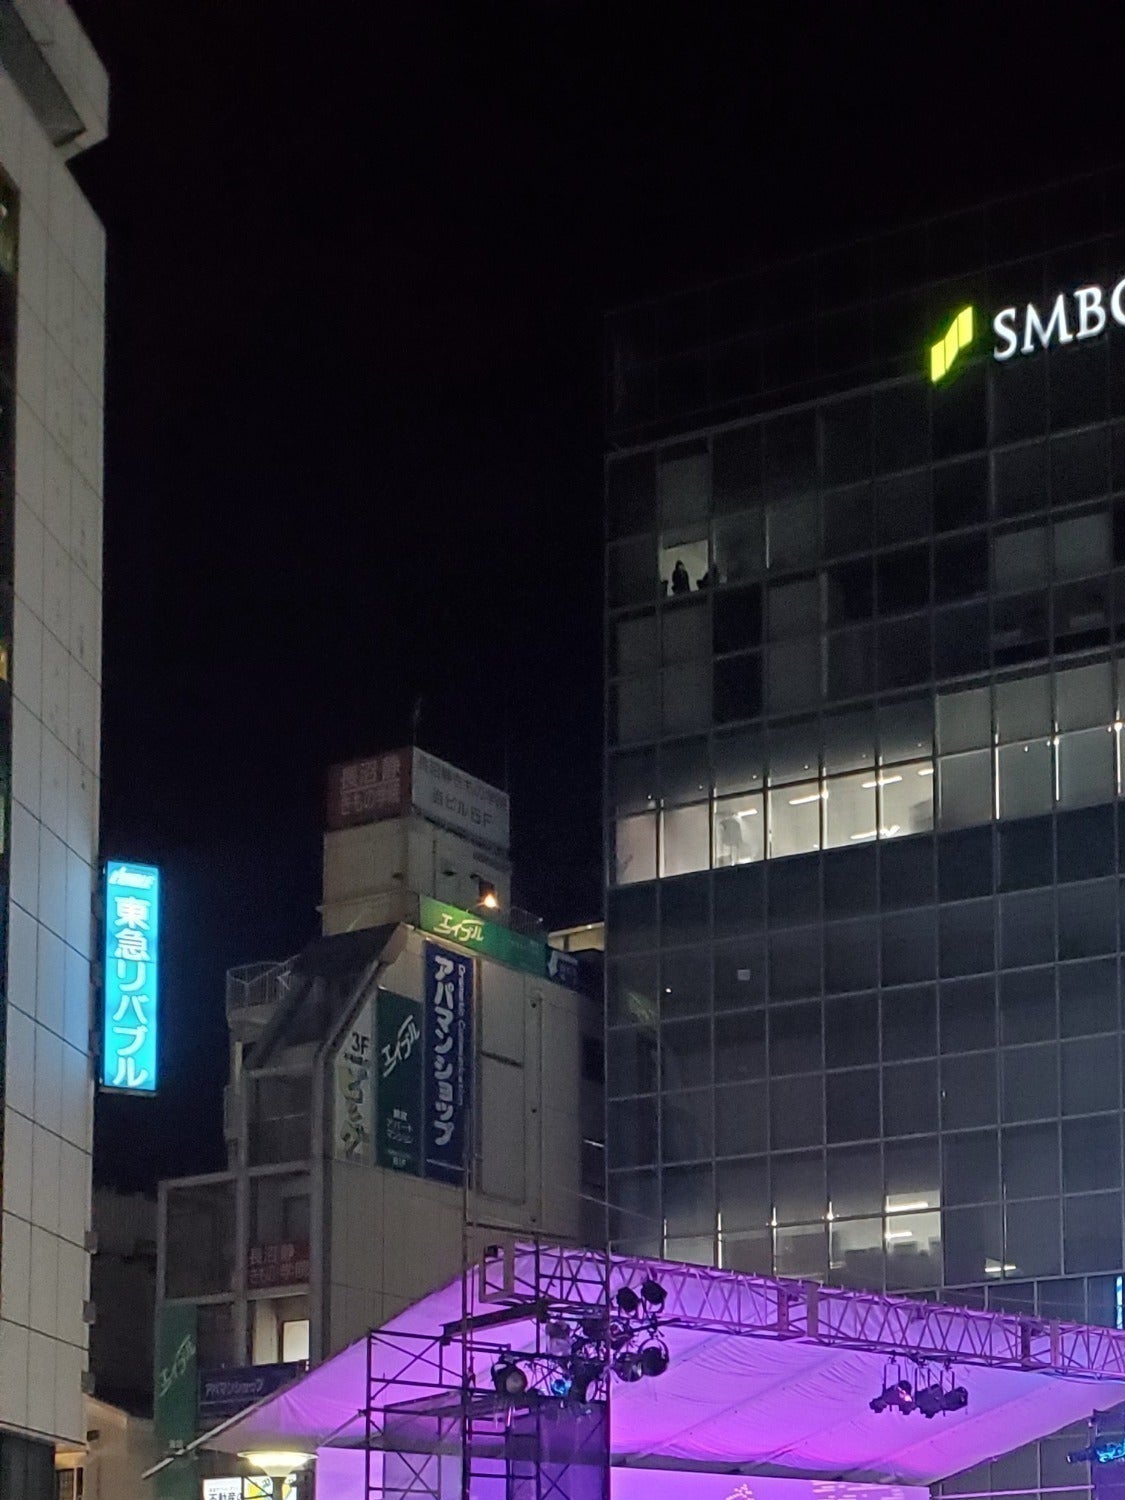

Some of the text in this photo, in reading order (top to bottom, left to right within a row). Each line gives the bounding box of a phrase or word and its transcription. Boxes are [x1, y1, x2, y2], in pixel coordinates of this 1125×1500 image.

[433, 912, 485, 942] エイブル
[112, 895, 151, 1087] 東急リバブル
[351, 1031, 369, 1055] 3F
[382, 1013, 421, 1079] エイブル
[433, 954, 455, 1146] アパマンショップ
